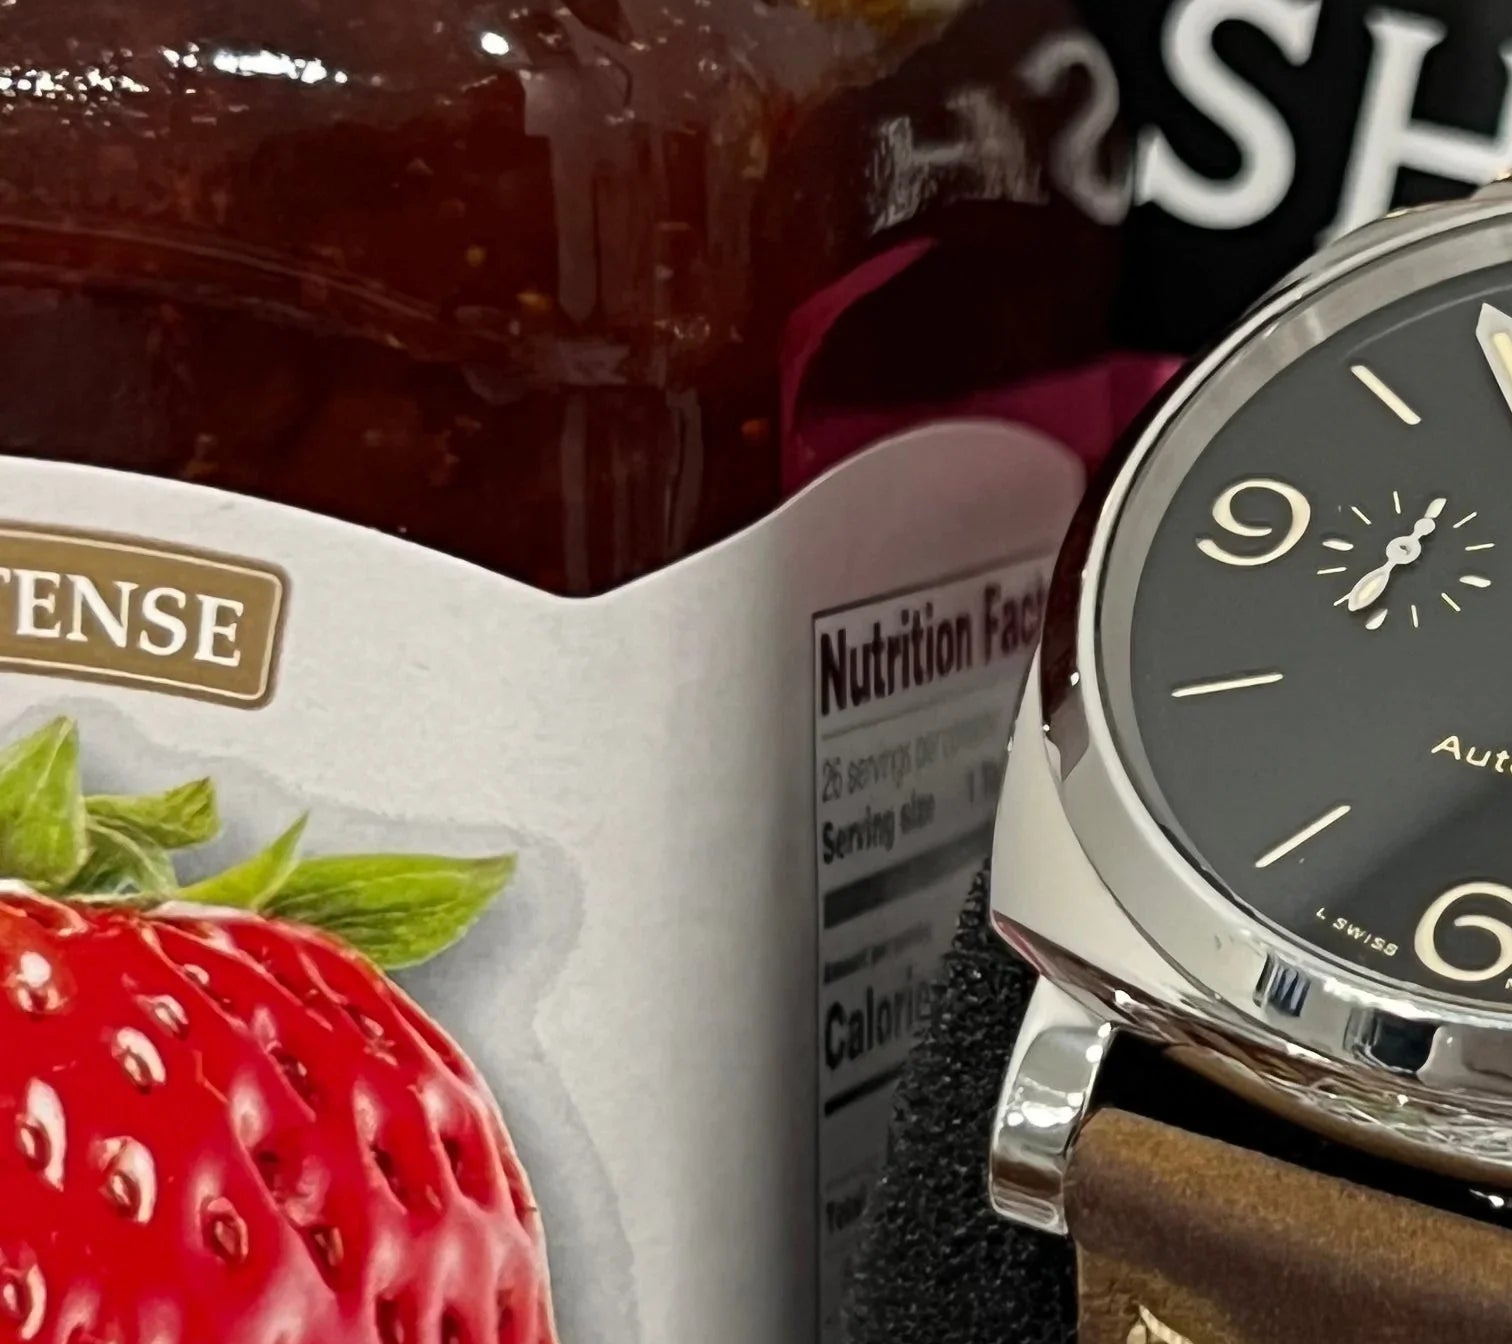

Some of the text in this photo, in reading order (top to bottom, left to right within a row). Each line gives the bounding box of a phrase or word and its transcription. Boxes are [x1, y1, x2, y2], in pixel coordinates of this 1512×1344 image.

[1195, 477, 1311, 567] 9
[819, 601, 973, 718] Nutrition
[1332, 917, 1399, 957] SWISS
